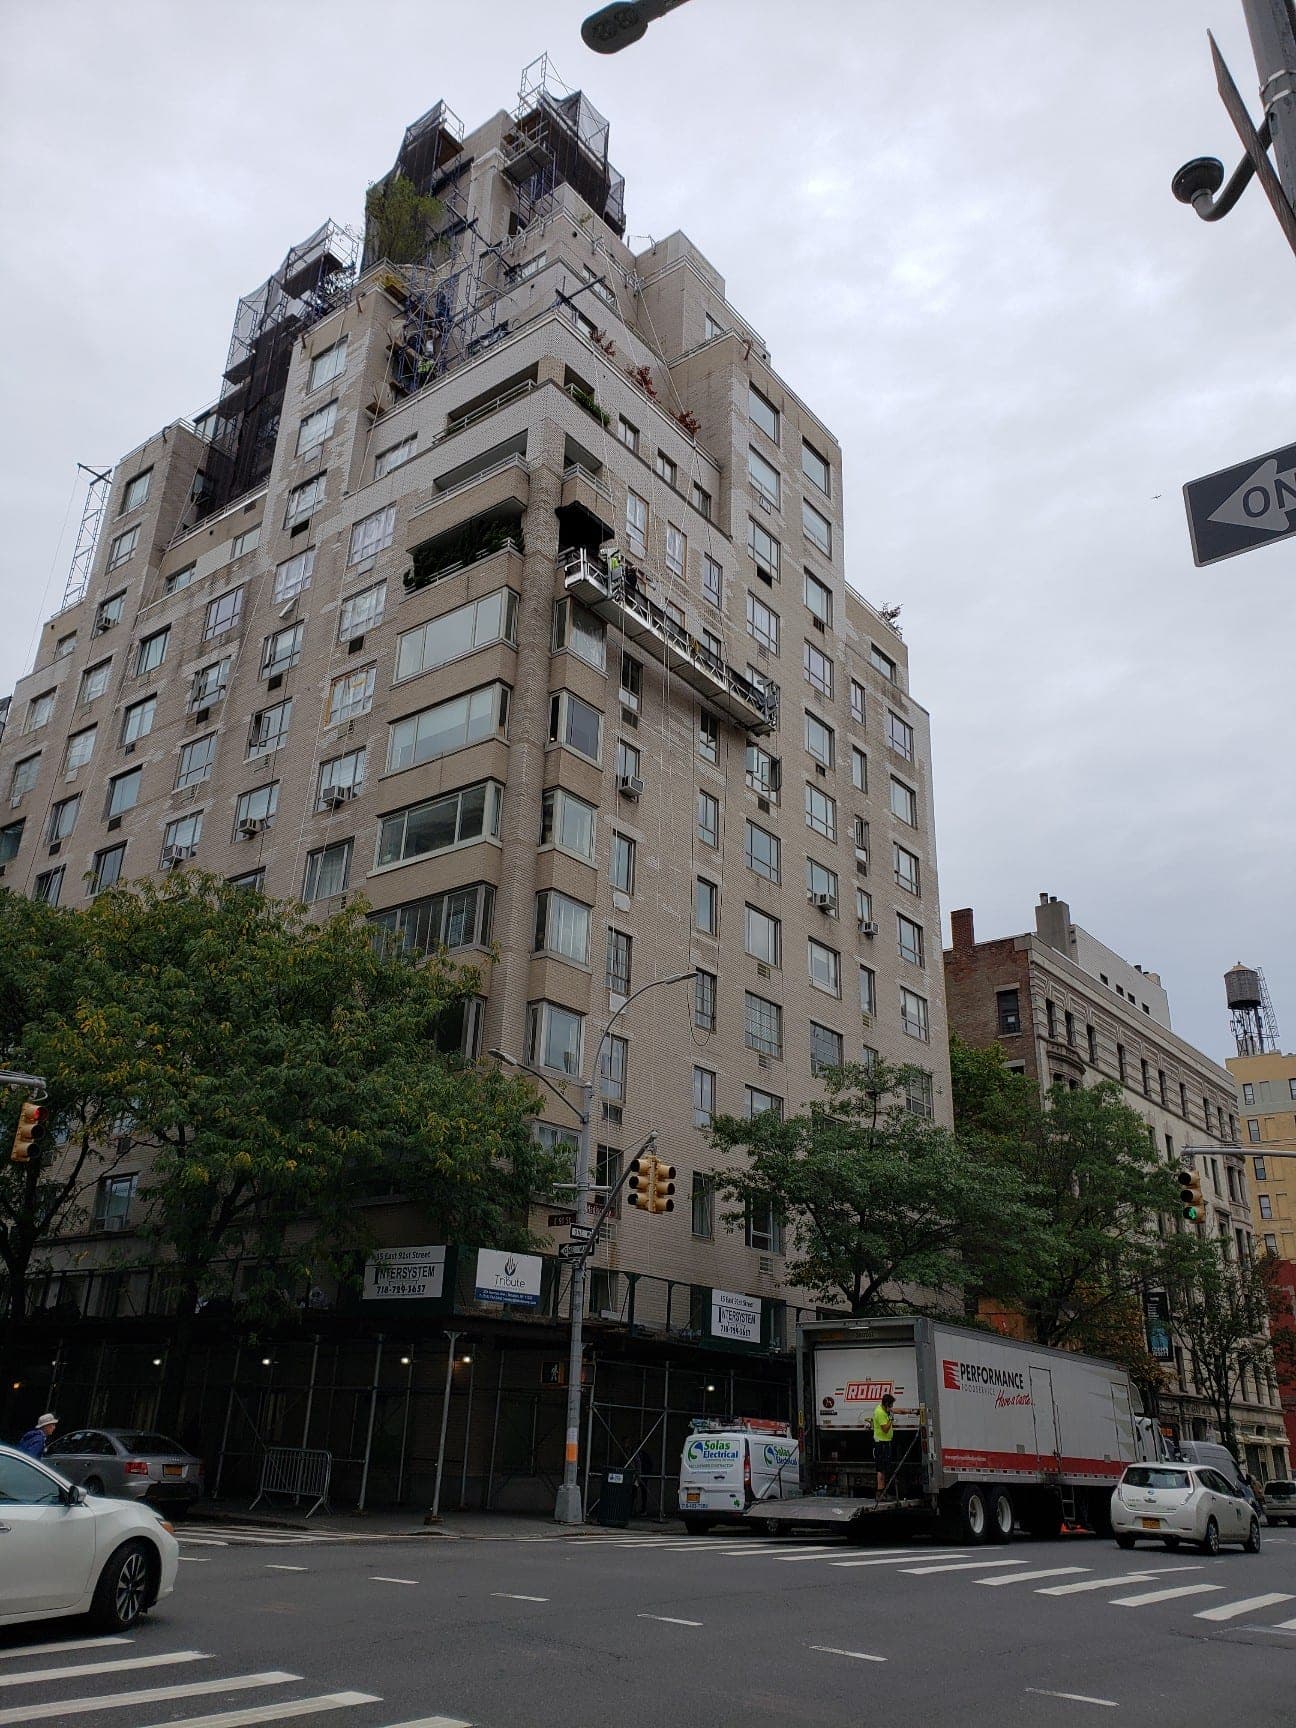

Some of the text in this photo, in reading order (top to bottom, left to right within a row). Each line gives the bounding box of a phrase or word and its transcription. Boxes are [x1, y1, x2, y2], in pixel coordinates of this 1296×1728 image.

[398, 1251, 411, 1260] 91st
[412, 1251, 431, 1259] Street
[373, 1266, 435, 1285] INTERSYSTEM
[495, 1274, 525, 1288] Tribute
[718, 1306, 756, 1325] INTERSYSTEM
[960, 1363, 1024, 1390] PERFORMANCE
[703, 1440, 731, 1451] Solas
[703, 1450, 739, 1459] Electrical
